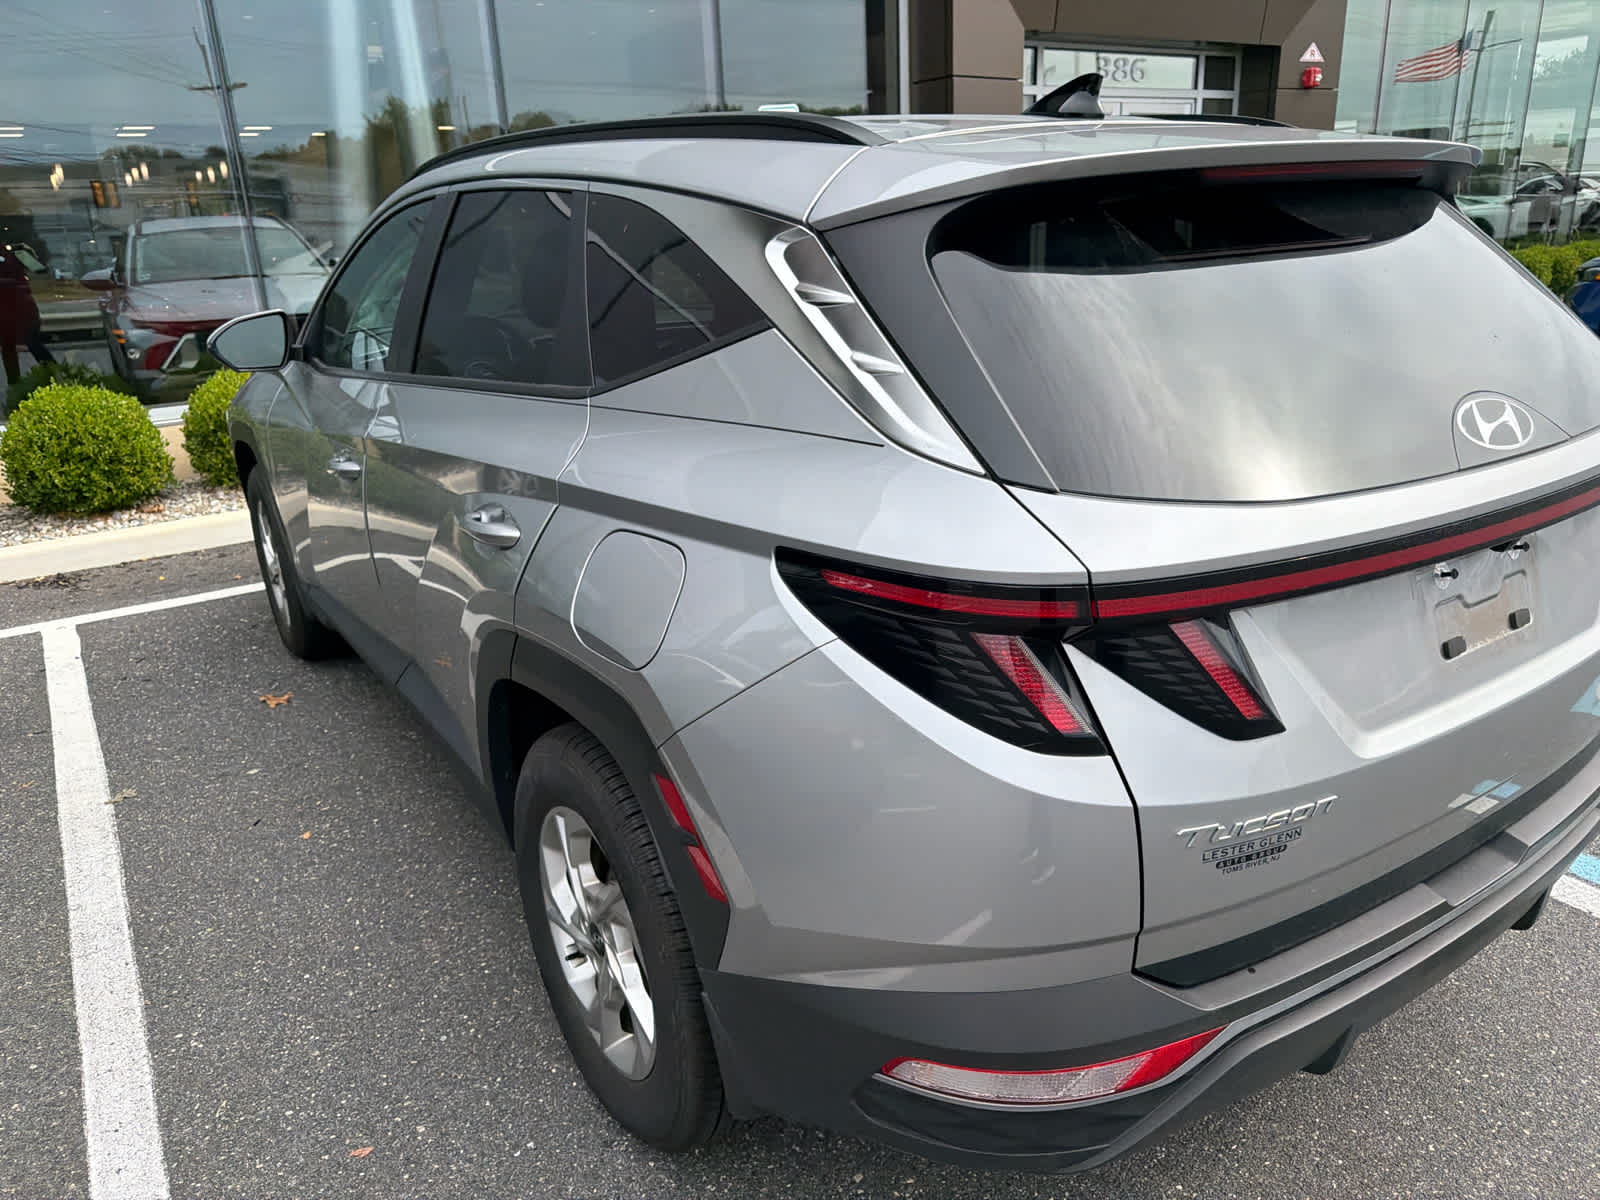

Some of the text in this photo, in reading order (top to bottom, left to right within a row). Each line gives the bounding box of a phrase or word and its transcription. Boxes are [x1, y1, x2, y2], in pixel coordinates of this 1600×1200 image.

[1176, 795, 1338, 847] TUCSON
[1202, 828, 1303, 861] LESTER GLENN
[1222, 863, 1245, 875] TOMS
